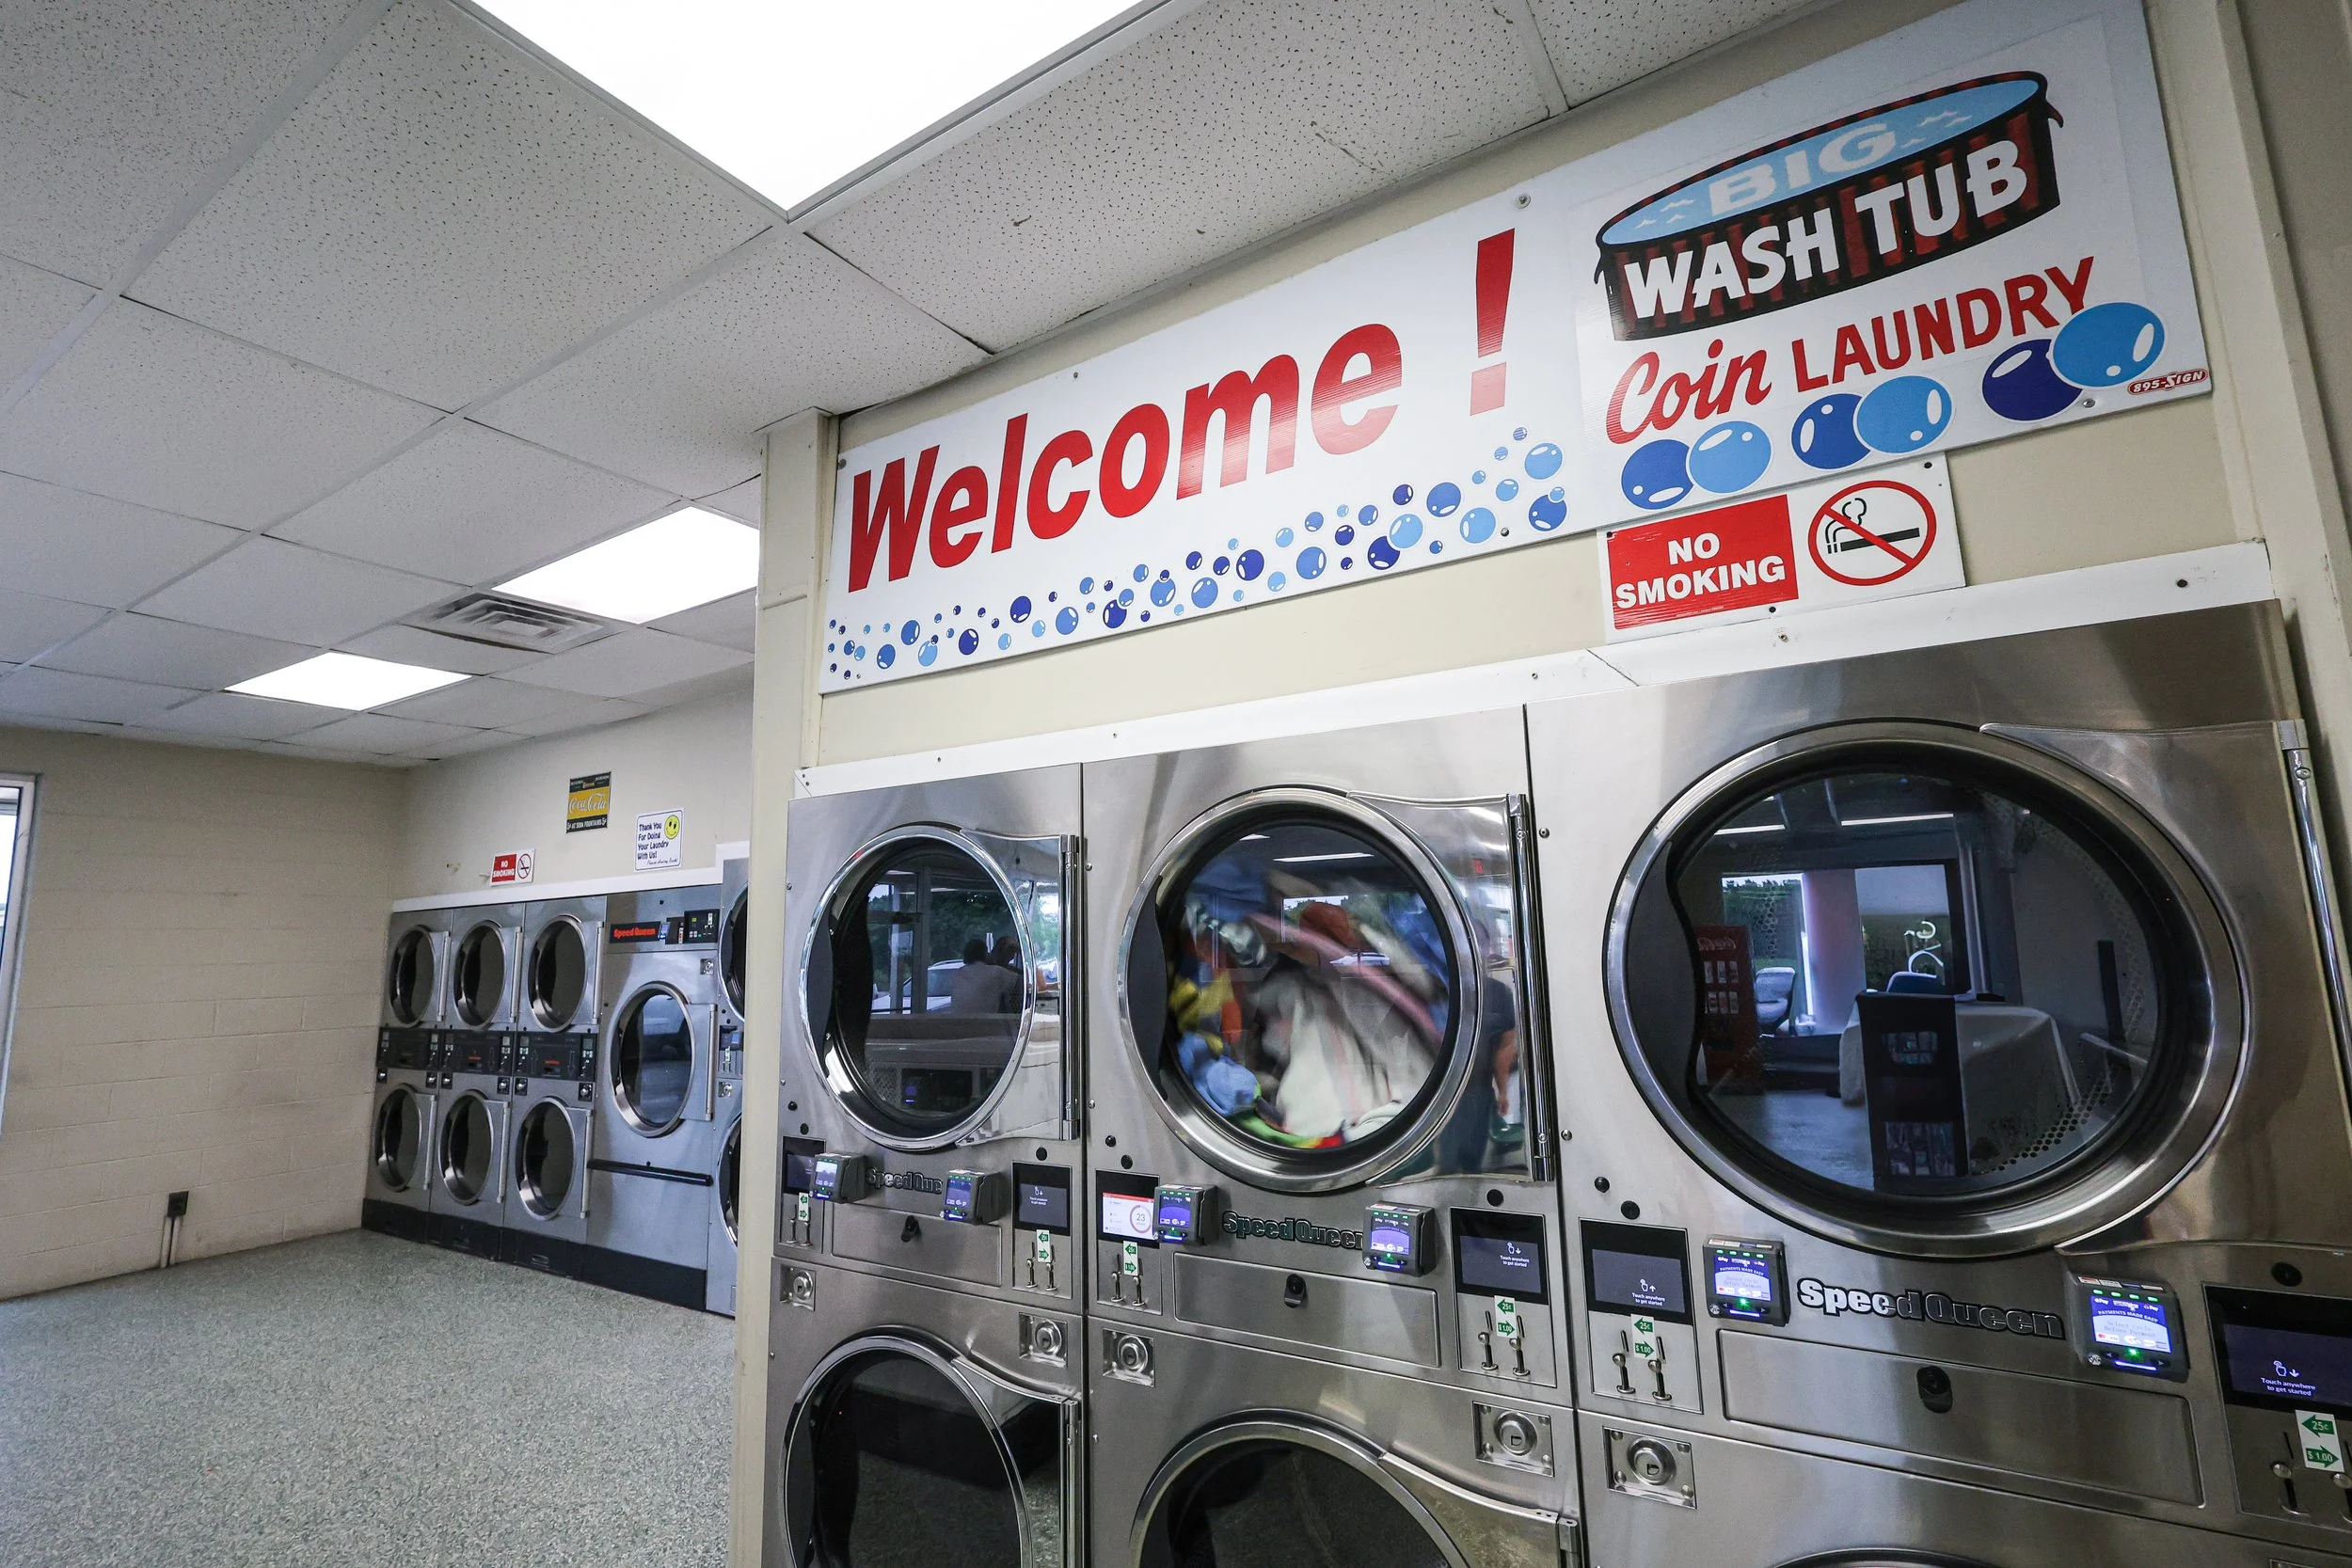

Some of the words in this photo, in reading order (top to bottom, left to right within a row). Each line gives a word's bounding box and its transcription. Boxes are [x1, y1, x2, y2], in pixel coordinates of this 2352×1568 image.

[1709, 122, 1896, 217] BIG
[1624, 207, 1841, 320] WASH
[1854, 139, 2028, 256] TUB
[1605, 338, 1772, 445] Coin
[1791, 256, 2094, 394] LAUNDRY
[2133, 371, 2203, 393] 895-SIGN
[848, 323, 1403, 594] Welcome
[1667, 532, 1721, 565] NO
[1615, 555, 1787, 610] SMOKING
[639, 823, 652, 832] Thank
[1797, 1277, 1925, 1322] Speed
[1925, 1291, 2066, 1340] Queen
[2260, 1377, 2282, 1386] Touch
[2282, 1380, 2316, 1391] anywhere
[2287, 1387, 2312, 1397] started
